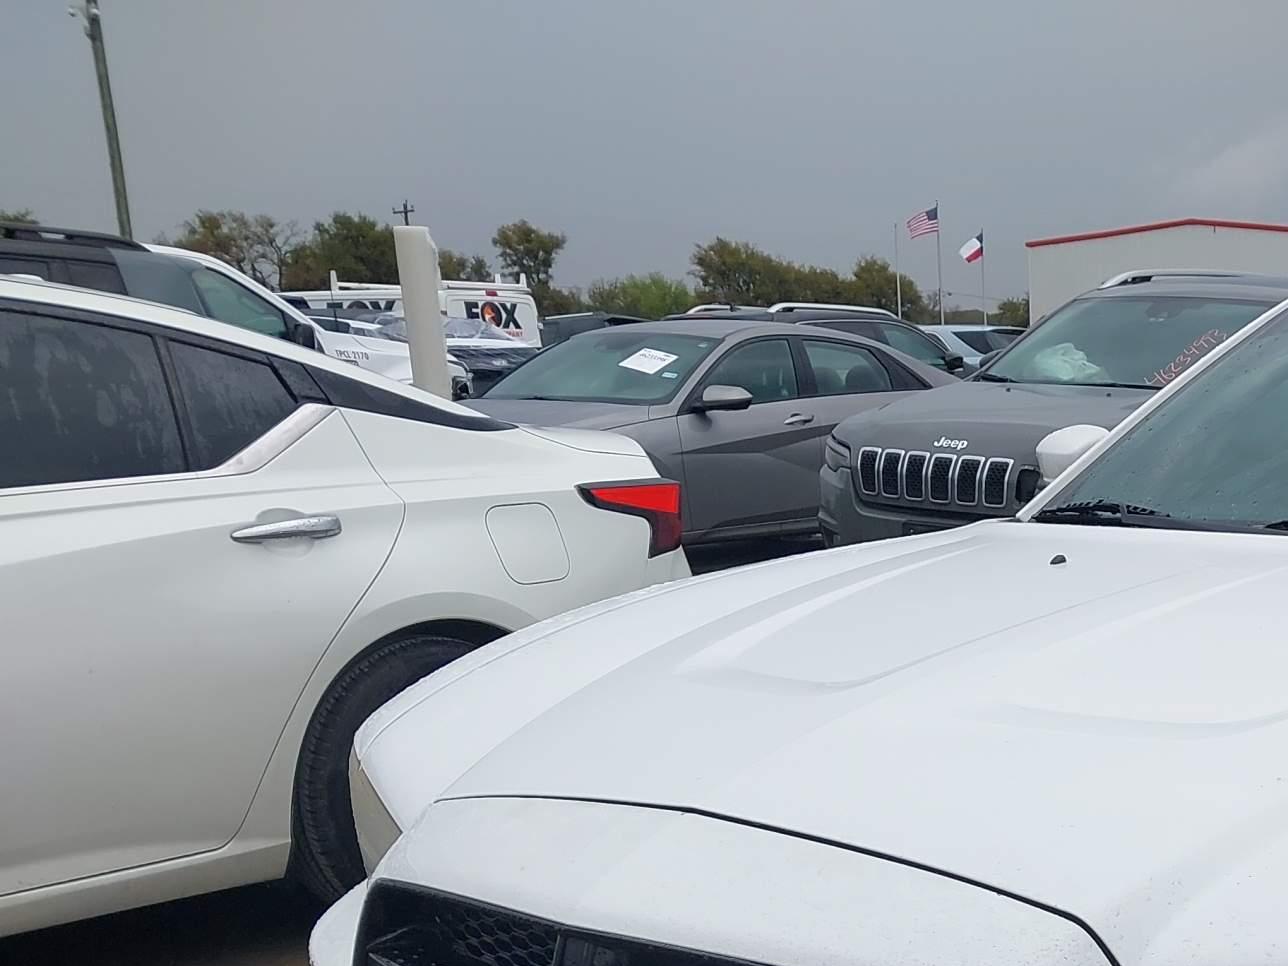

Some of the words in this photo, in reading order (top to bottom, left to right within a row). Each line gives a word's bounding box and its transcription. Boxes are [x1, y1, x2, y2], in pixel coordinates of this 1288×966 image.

[464, 301, 522, 330] FOX
[352, 351, 370, 361] 2170
[933, 436, 968, 451] Jeep
